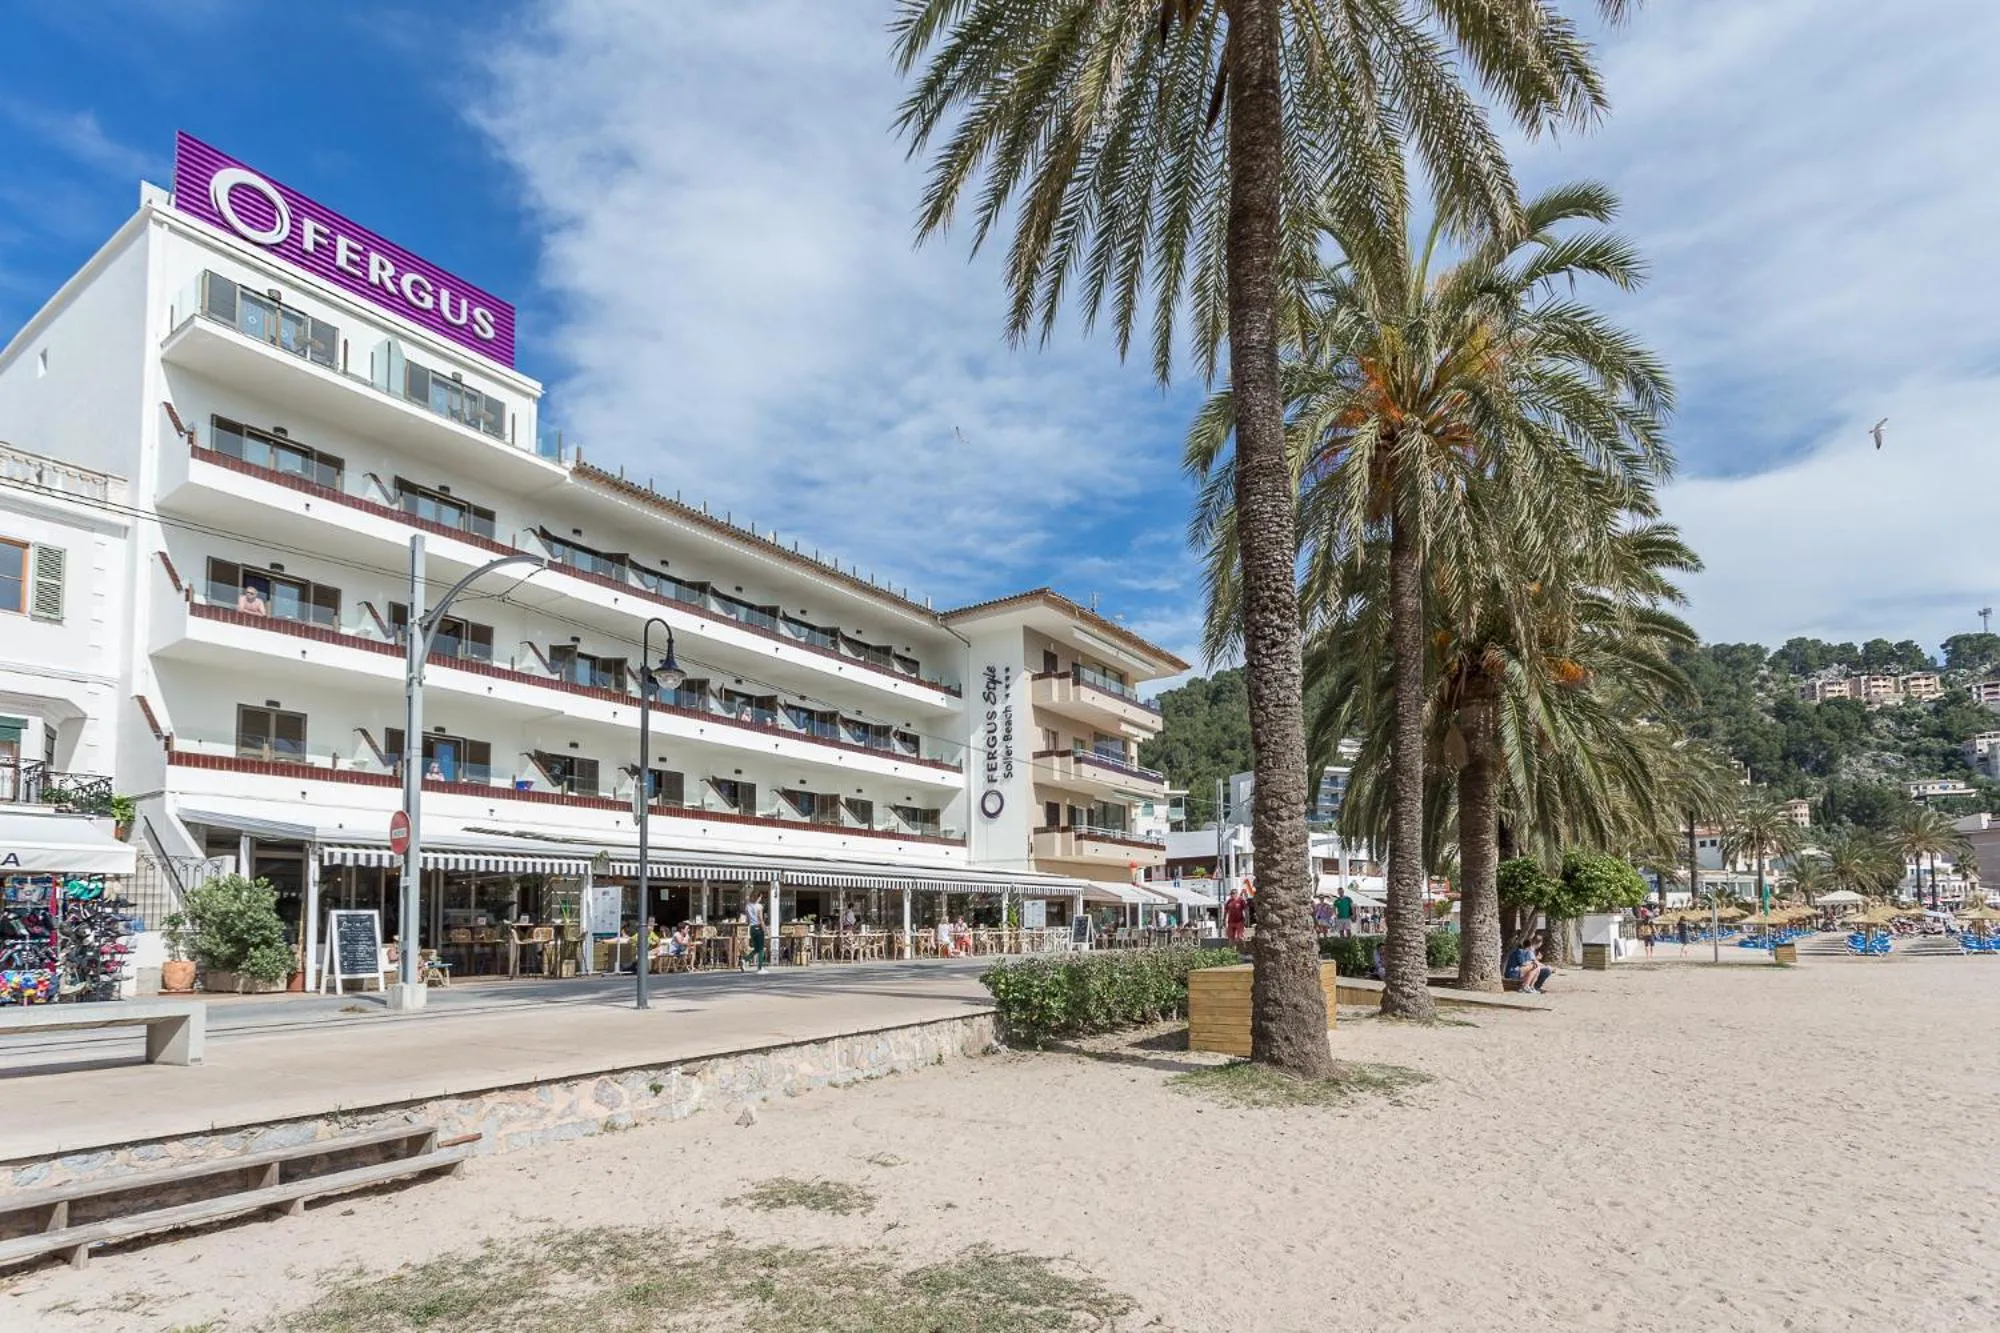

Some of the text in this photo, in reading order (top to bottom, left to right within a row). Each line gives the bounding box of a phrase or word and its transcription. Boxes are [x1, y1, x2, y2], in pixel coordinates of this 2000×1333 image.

[302, 217, 496, 340] FERGUS
[982, 665, 1003, 706] Style
[986, 710, 998, 784] FERGUS
[1002, 704, 1013, 779] Soller Beach
